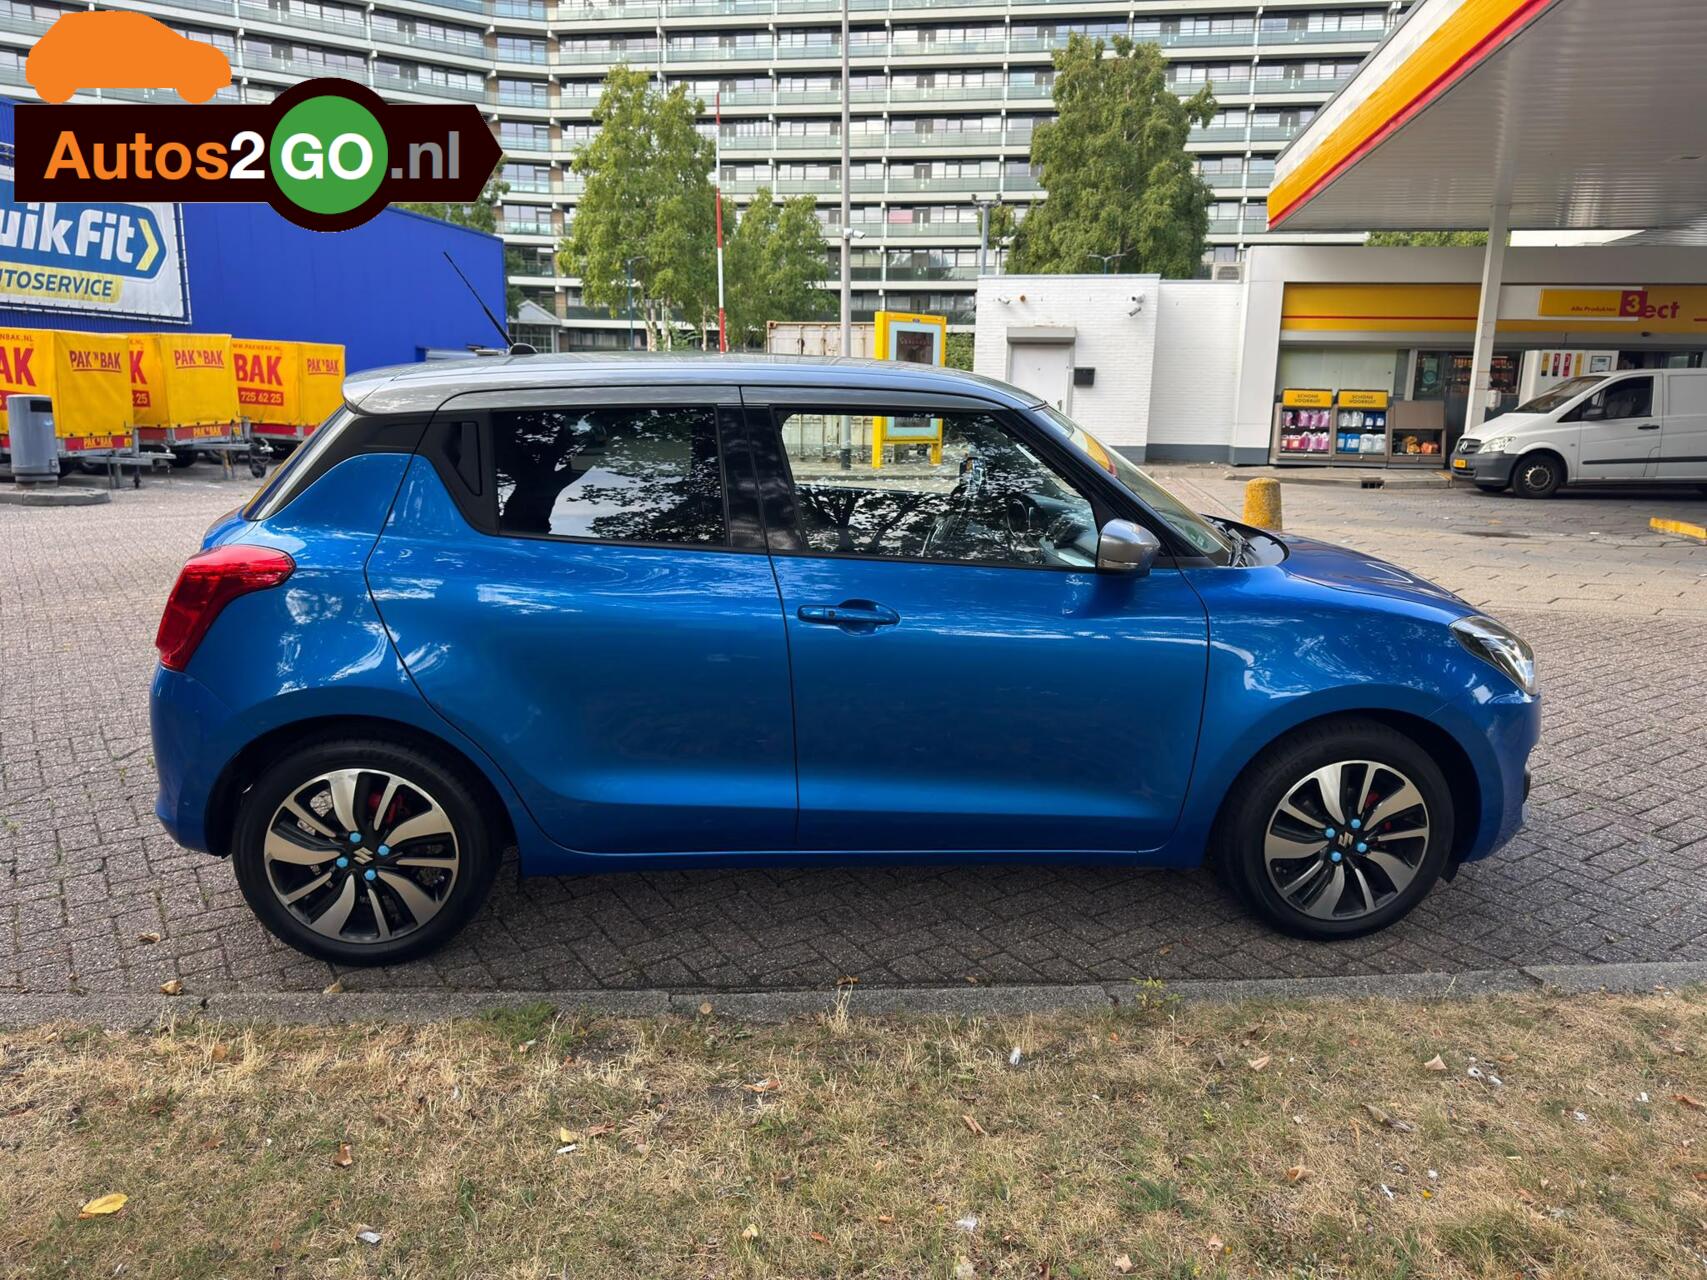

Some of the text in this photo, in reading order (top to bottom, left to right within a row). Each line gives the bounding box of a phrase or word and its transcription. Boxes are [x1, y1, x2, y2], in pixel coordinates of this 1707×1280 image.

[69, 350, 92, 368] PAK
[100, 351, 121, 370] BAK
[174, 350, 196, 366] PAK
[203, 350, 224, 366] BAK
[234, 353, 283, 386] BAK
[135, 393, 148, 404] 25
[240, 391, 257, 402] 725
[270, 393, 282, 404] 25
